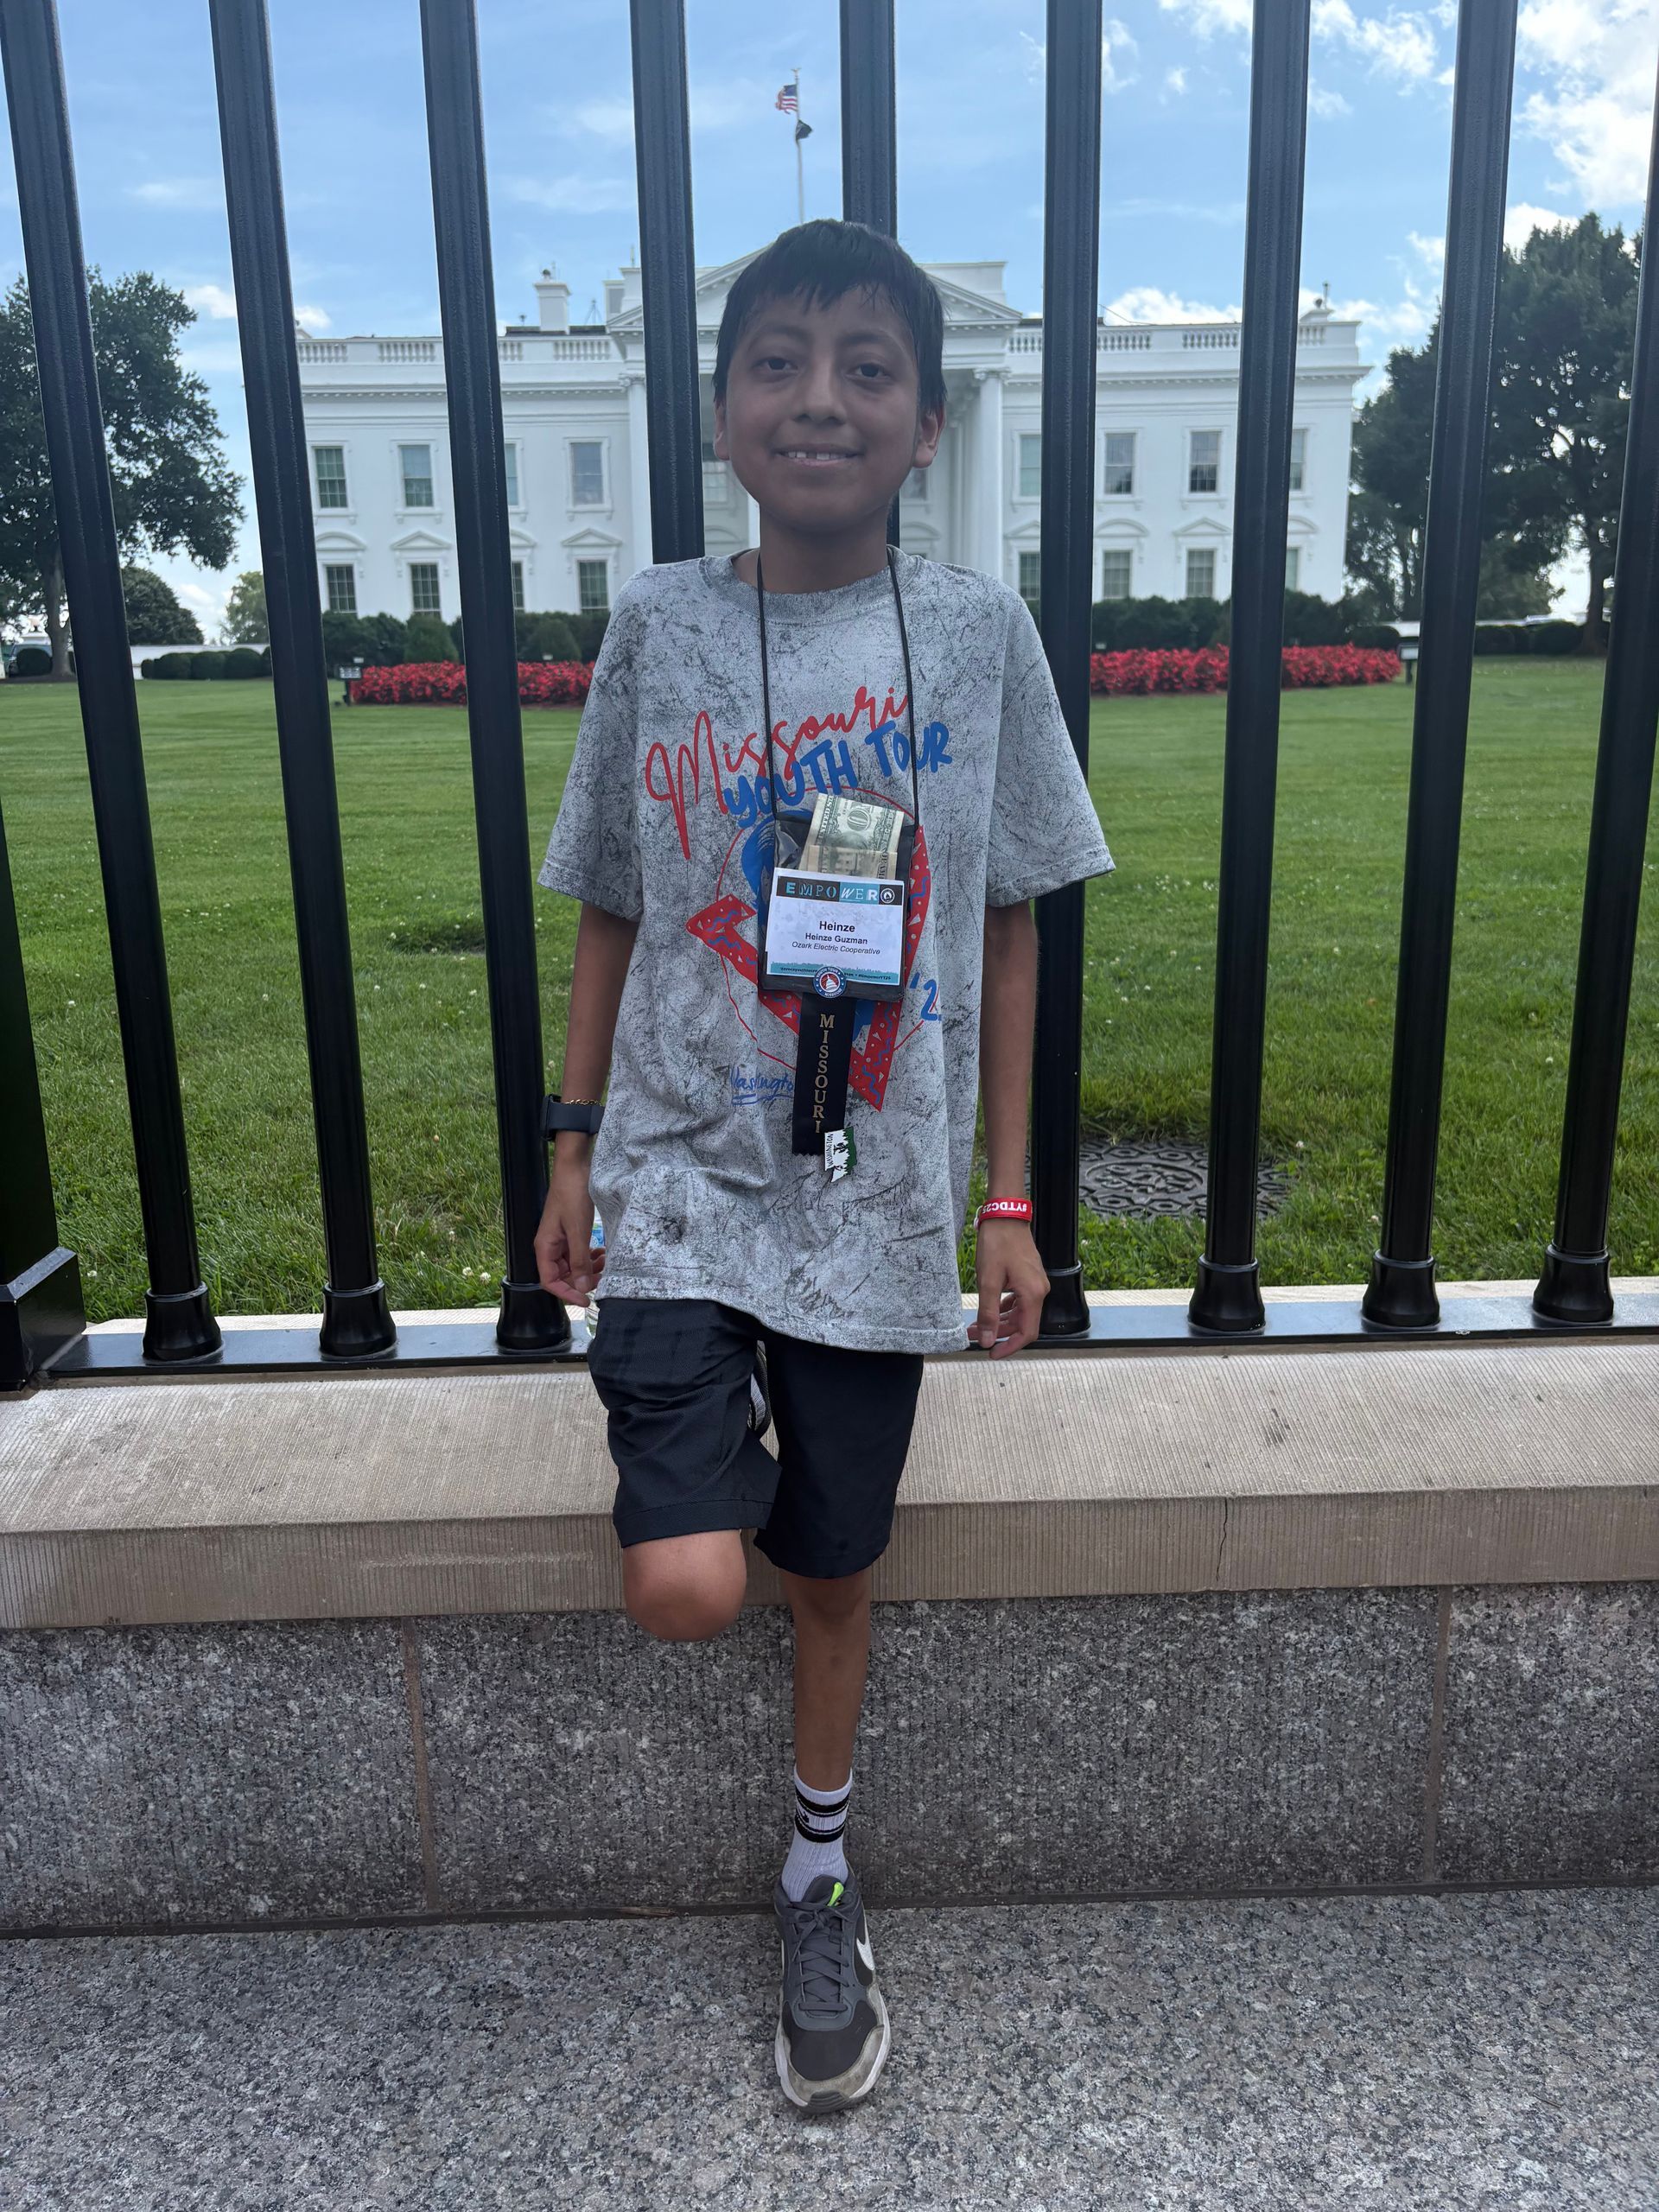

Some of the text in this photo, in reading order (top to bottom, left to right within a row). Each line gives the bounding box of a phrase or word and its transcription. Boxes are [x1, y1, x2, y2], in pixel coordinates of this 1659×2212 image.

[865, 720, 952, 777] TOUR
[645, 686, 908, 860] Missouri
[785, 881, 878, 901] EMPOWER
[804, 932, 868, 944] Heinze Guzman
[819, 920, 855, 932] Heinze
[791, 941, 880, 955] Ozark Electric Cooperative
[909, 972, 942, 1021] '2
[812, 1013, 835, 1134] MISSOURI
[825, 1133, 834, 1166] WASHINGTON
[982, 1201, 1027, 1214] #YTDC25
